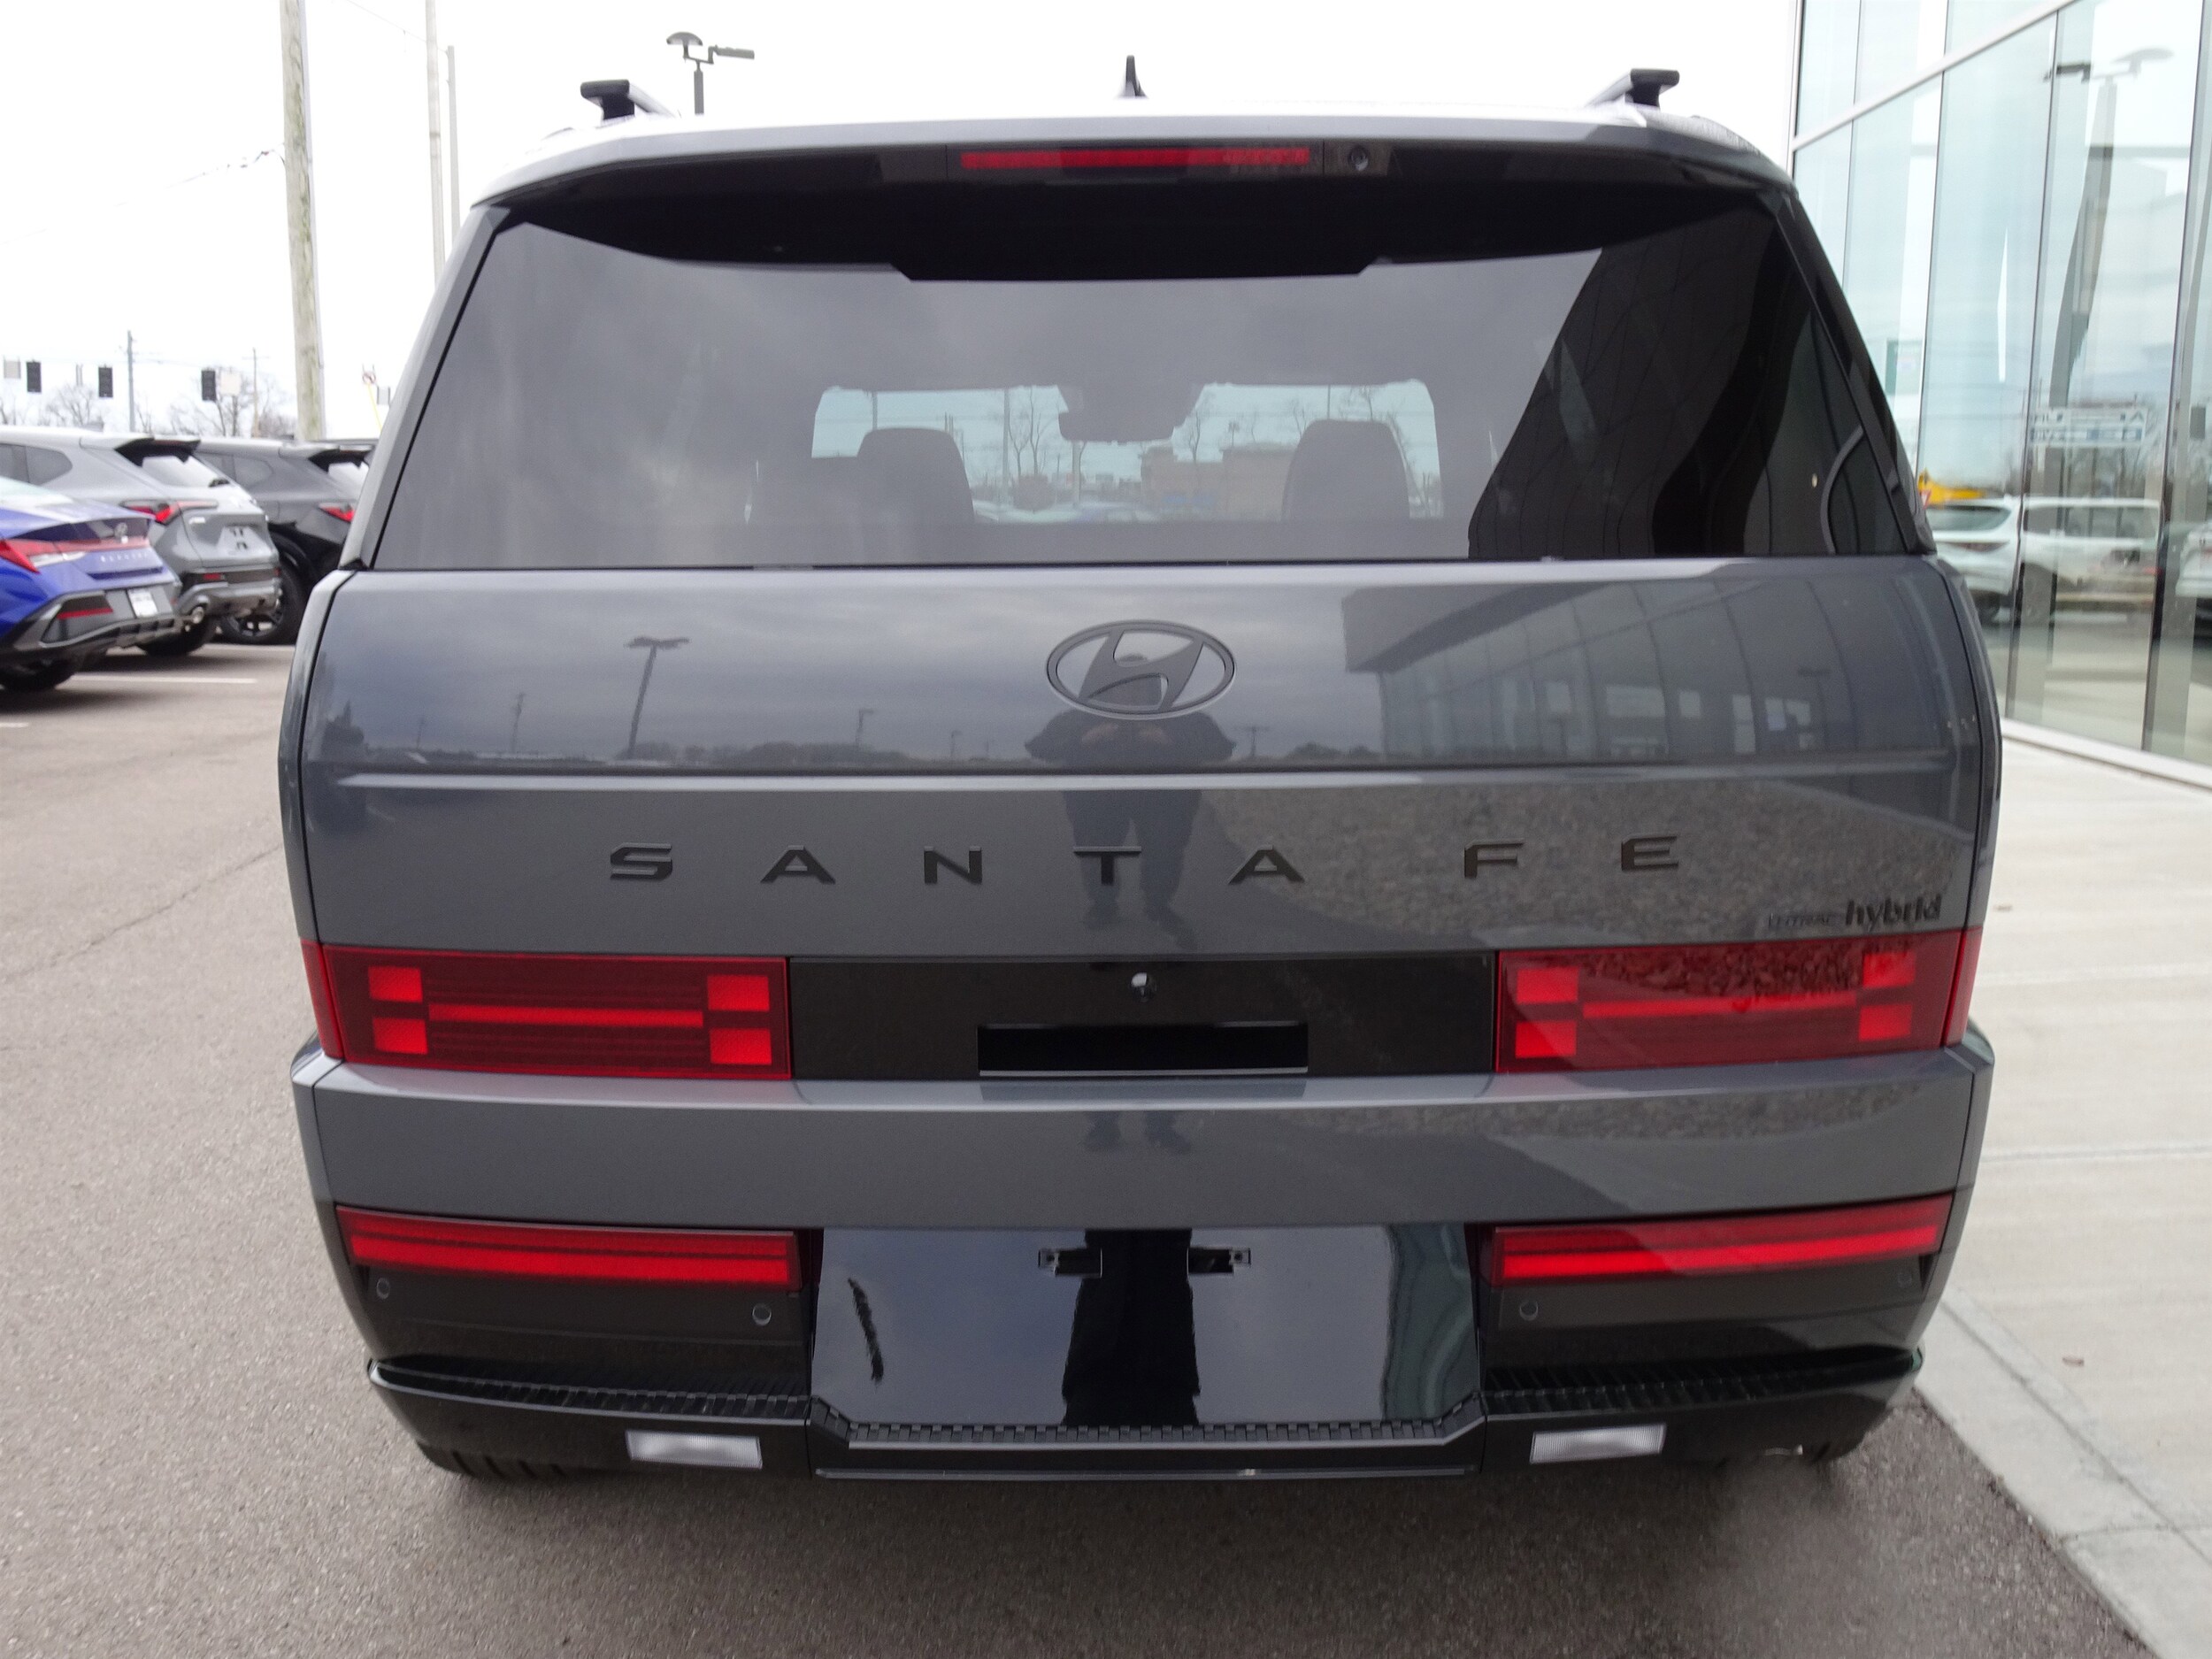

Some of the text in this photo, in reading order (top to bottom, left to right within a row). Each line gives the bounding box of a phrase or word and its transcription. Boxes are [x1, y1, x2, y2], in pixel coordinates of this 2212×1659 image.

[610, 834, 1680, 885] SANTA FE
[1845, 893, 1943, 933] hybrid
